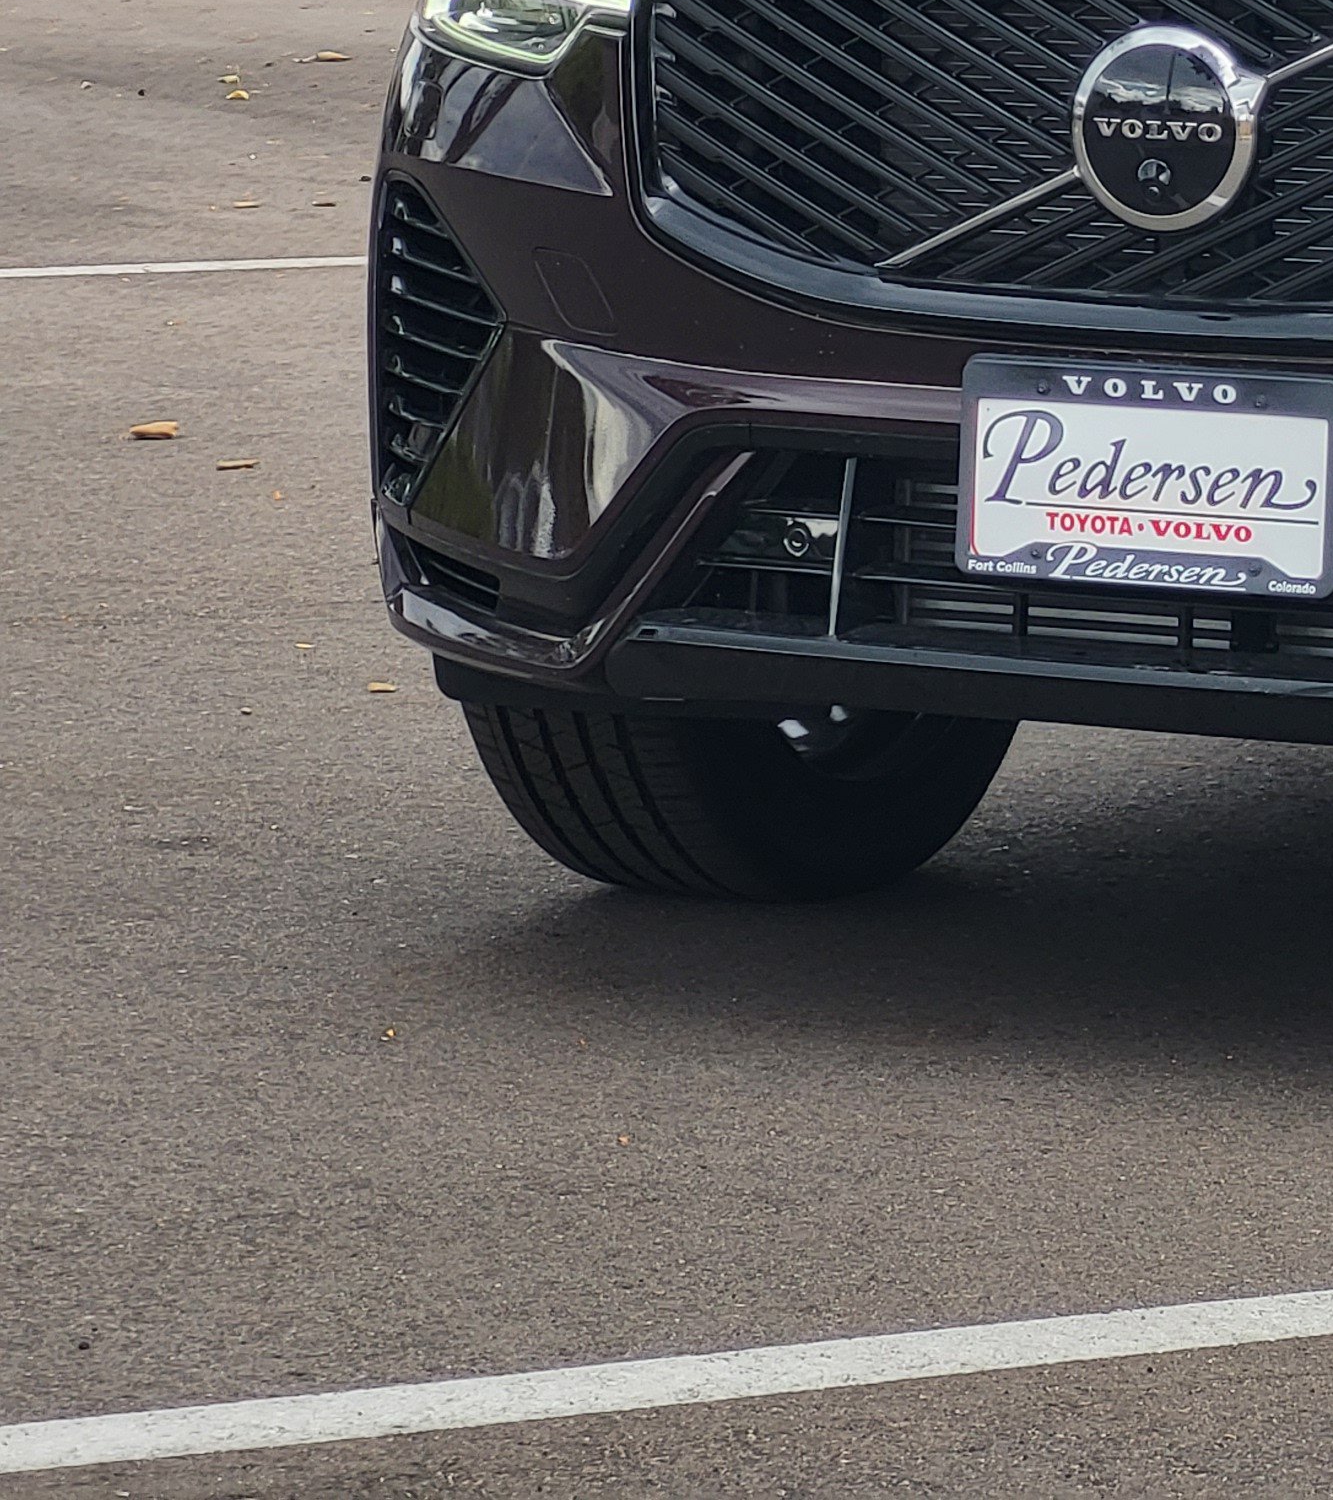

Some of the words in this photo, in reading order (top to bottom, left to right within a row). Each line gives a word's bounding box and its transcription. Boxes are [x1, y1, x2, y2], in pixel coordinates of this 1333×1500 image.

[1093, 117, 1222, 142] VOLVO
[1062, 375, 1237, 405] VOLVO
[983, 409, 1317, 511] Pedersen
[1045, 511, 1132, 536] TOYOTA
[1149, 520, 1253, 542] VOLVO
[967, 559, 993, 572] Fort
[996, 560, 1037, 575] Collins
[1045, 542, 1246, 587] Pedersen
[1268, 580, 1316, 595] Colorado
